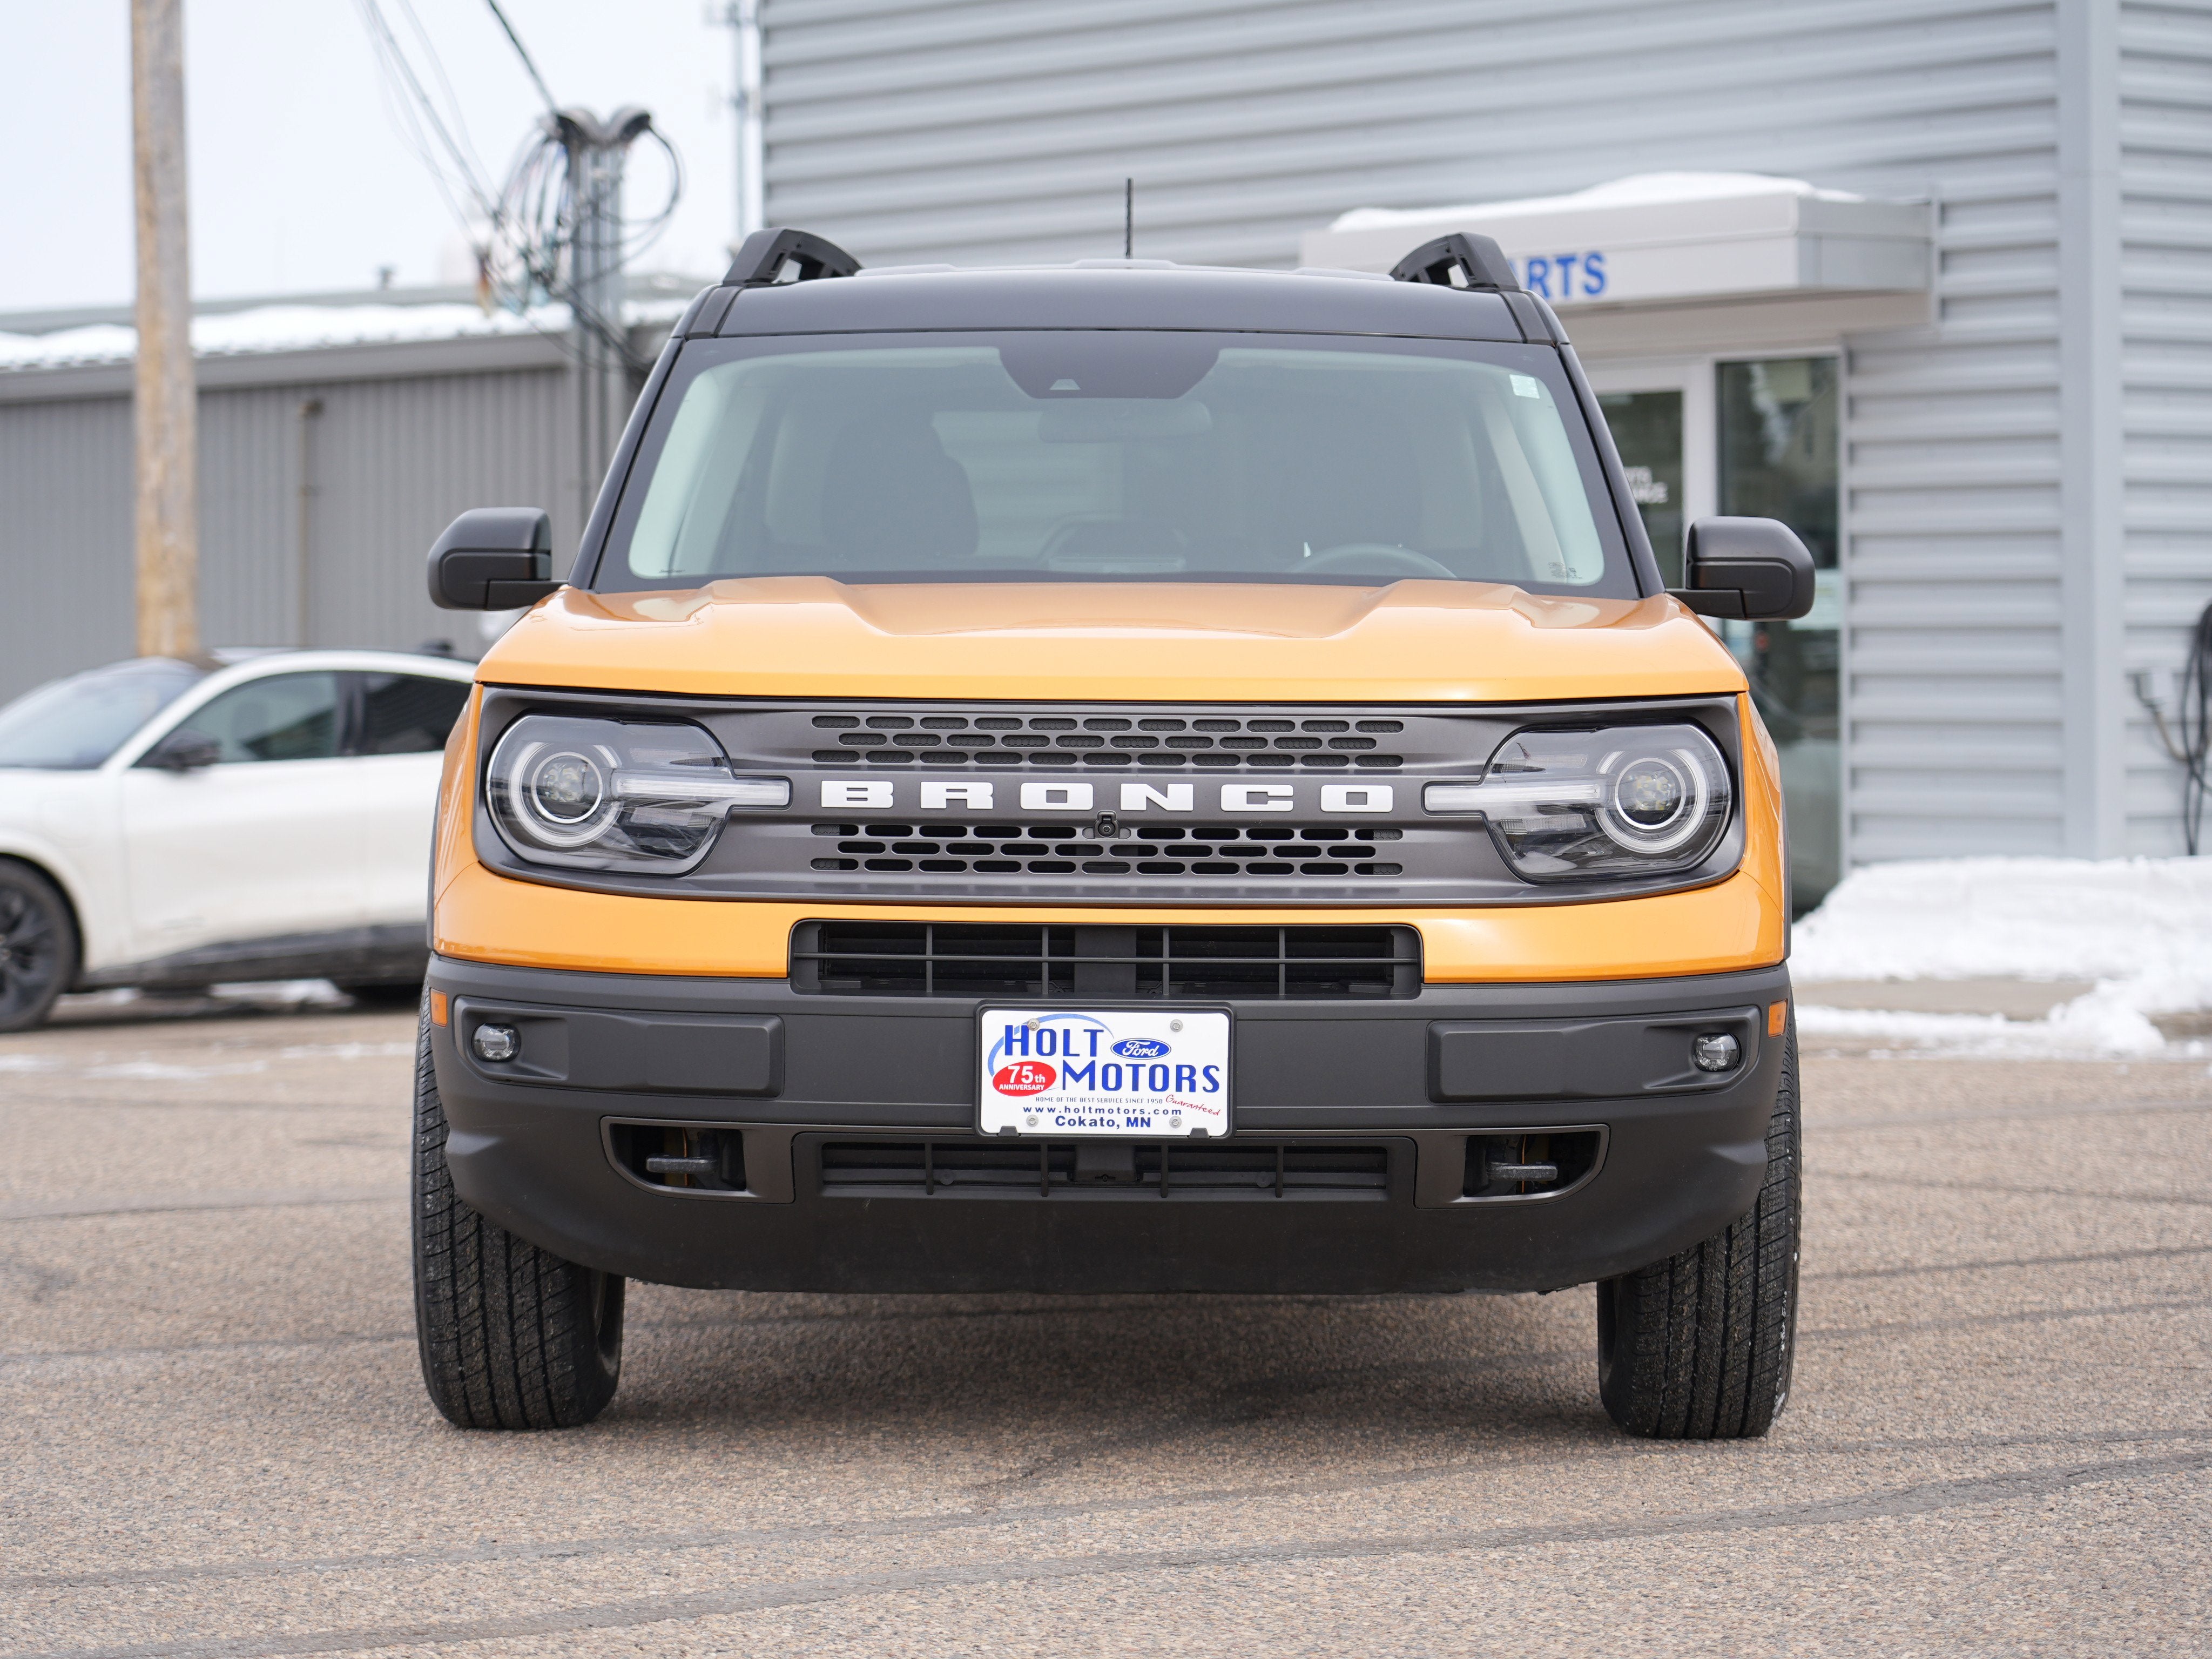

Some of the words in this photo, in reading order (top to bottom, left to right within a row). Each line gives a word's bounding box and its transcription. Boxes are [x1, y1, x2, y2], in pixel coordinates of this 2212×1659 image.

[1508, 251, 1606, 299] RTS
[821, 780, 1394, 813] BRONCO
[1004, 1025, 1104, 1057] HOLT
[1122, 1040, 1161, 1057] Ford
[1007, 1065, 1046, 1084] 75th
[1062, 1060, 1220, 1093] MOTORS
[1023, 1105, 1182, 1116] www.holtmotors.com
[1165, 1094, 1221, 1116] Guaranteed
[1055, 1115, 1120, 1130] Cokato,
[1126, 1116, 1151, 1128] MN
